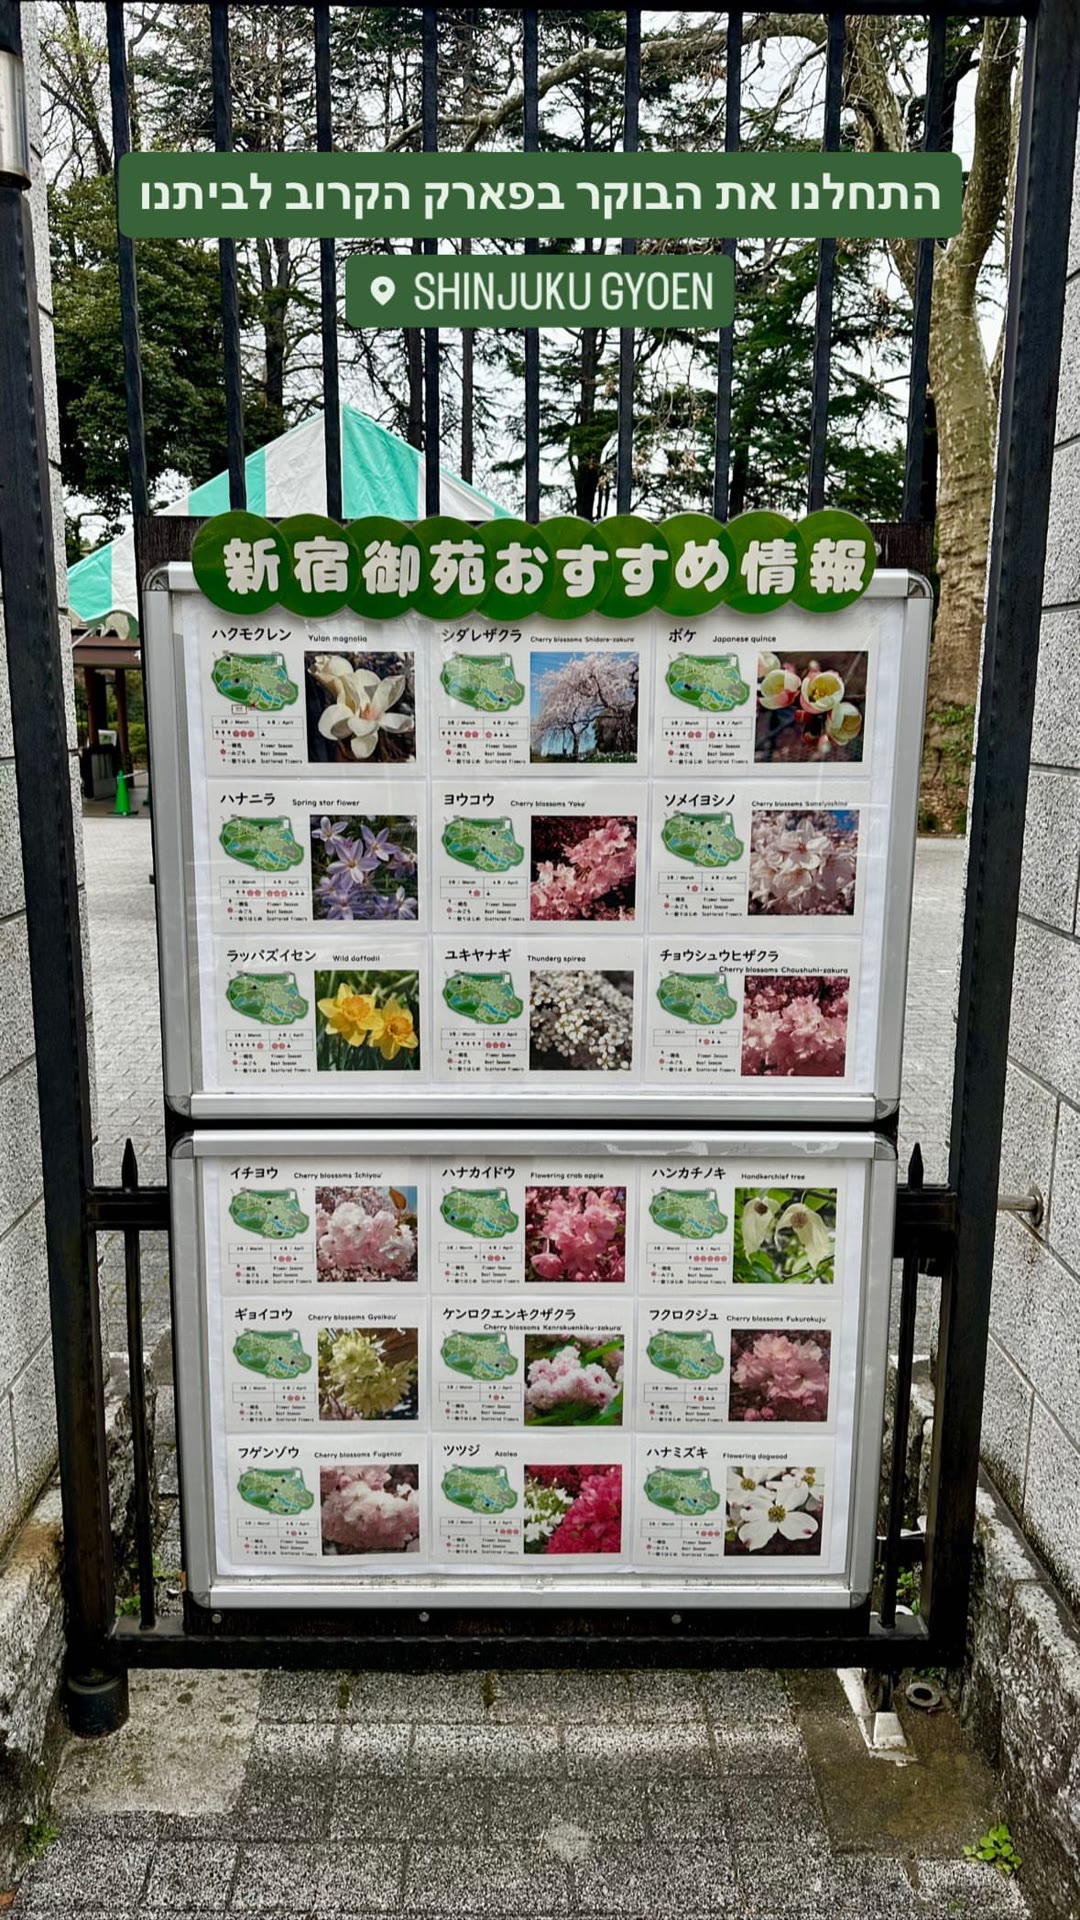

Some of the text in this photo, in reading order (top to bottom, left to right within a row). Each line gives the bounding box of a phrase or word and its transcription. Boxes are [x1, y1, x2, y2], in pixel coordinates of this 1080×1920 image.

[223, 538, 867, 596] 新宿御苑おすすめ情報
[212, 627, 292, 641] ハクモクレン
[308, 634, 367, 644] Yulan magnolia
[441, 628, 522, 643] シダレザクラ
[530, 636, 552, 644] Cherry
[669, 628, 697, 643] ボケ
[713, 635, 776, 644] Japanese quince
[220, 792, 276, 805] ハナニラ
[292, 799, 360, 808] Spring star flower
[444, 793, 495, 807] ヨウコウ
[510, 800, 533, 808] Cherry
[664, 793, 736, 807] ソメイヨシノ
[445, 948, 511, 962] ユキヤナギ
[527, 955, 586, 963] Thunderg spirea
[660, 949, 779, 962] チョウシュウヒザクラ
[719, 966, 744, 974] Cherry
[230, 1166, 278, 1179] イチヨウ
[294, 1172, 318, 1180] Cherry
[442, 1166, 515, 1179] ハナカイドウ
[530, 1172, 564, 1180] Flowering
[652, 1166, 726, 1180] ハンカチノキ
[235, 1308, 293, 1321] ギョイコウ
[443, 1308, 576, 1321] ケンロクエンキクザクラ
[650, 1309, 719, 1321] フクロクジュ
[726, 1315, 750, 1323] Cherry
[238, 1446, 299, 1459] フゲンゾウ
[444, 1444, 480, 1457] ツツジ
[646, 1446, 708, 1459] ハナミズキ
